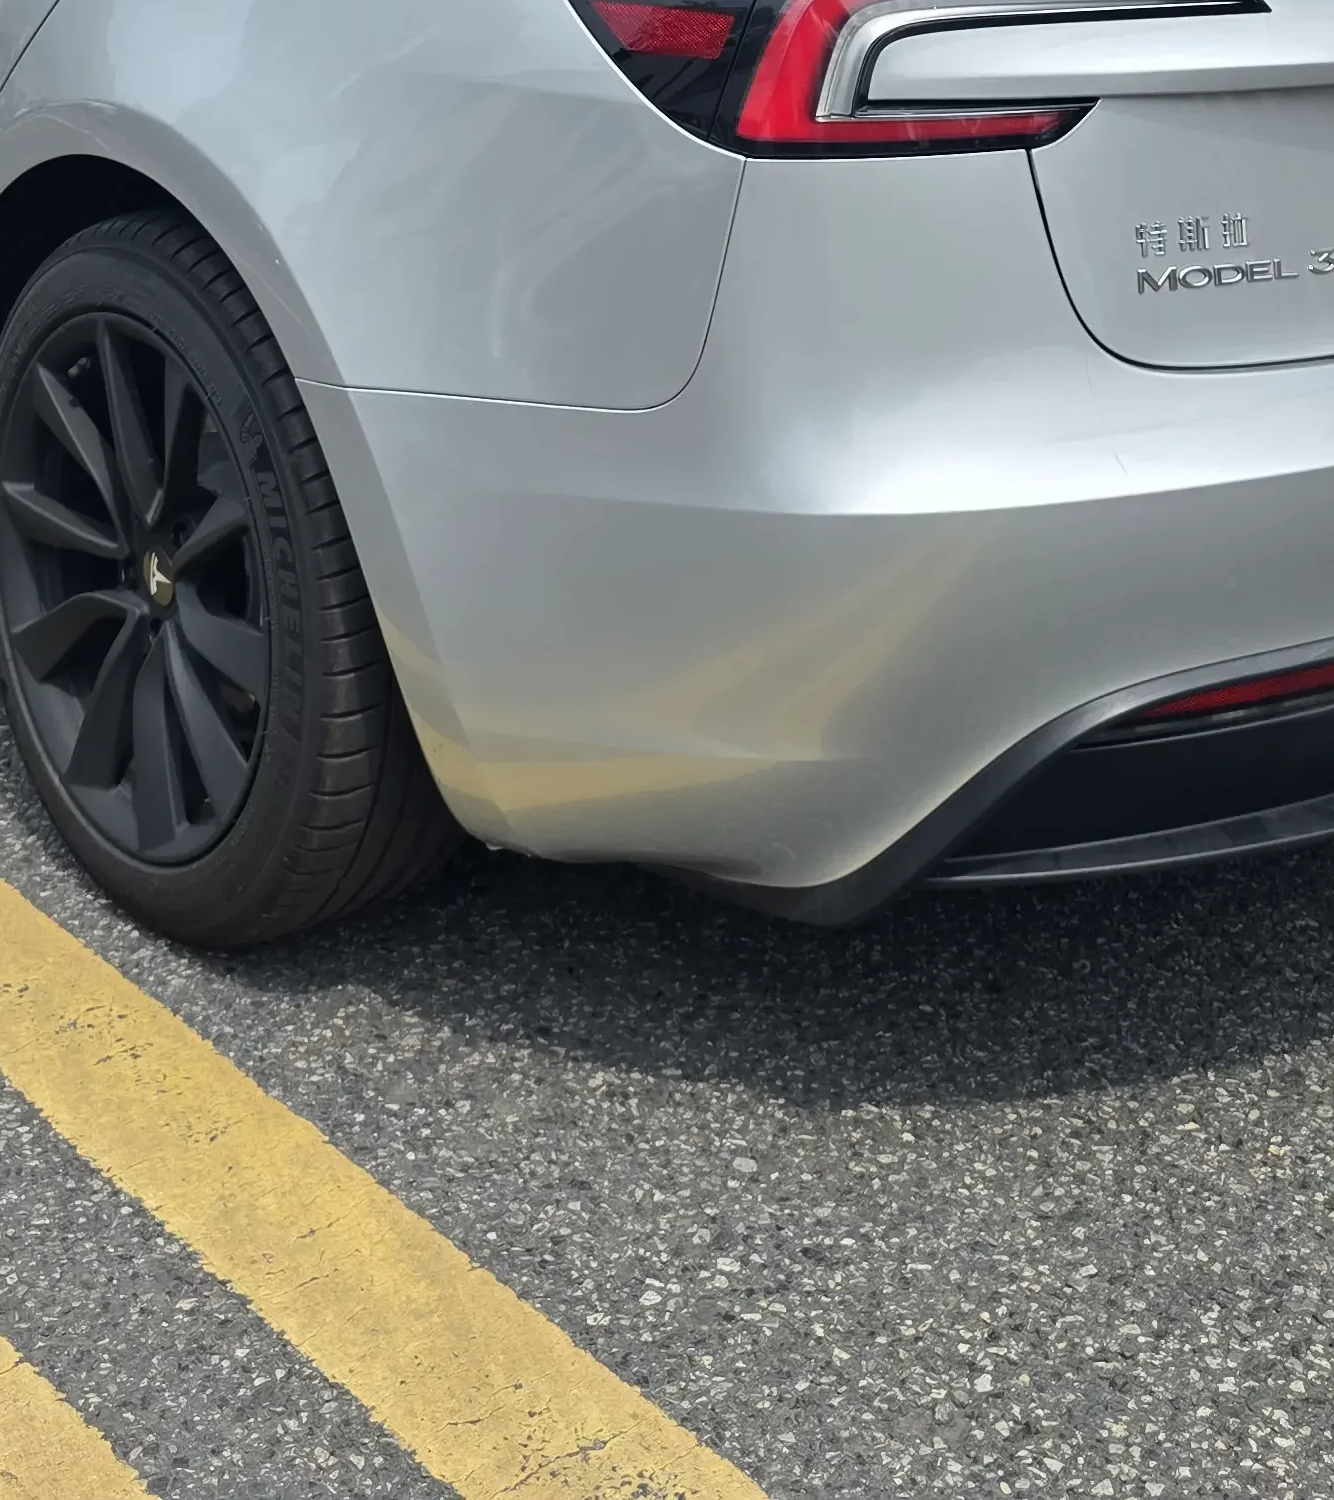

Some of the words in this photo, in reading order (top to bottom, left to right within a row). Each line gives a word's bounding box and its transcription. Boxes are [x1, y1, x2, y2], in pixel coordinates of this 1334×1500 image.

[1134, 211, 1250, 258] 特斯拉
[1137, 257, 1300, 295] MODEL
[253, 470, 302, 727] MICHELIN
